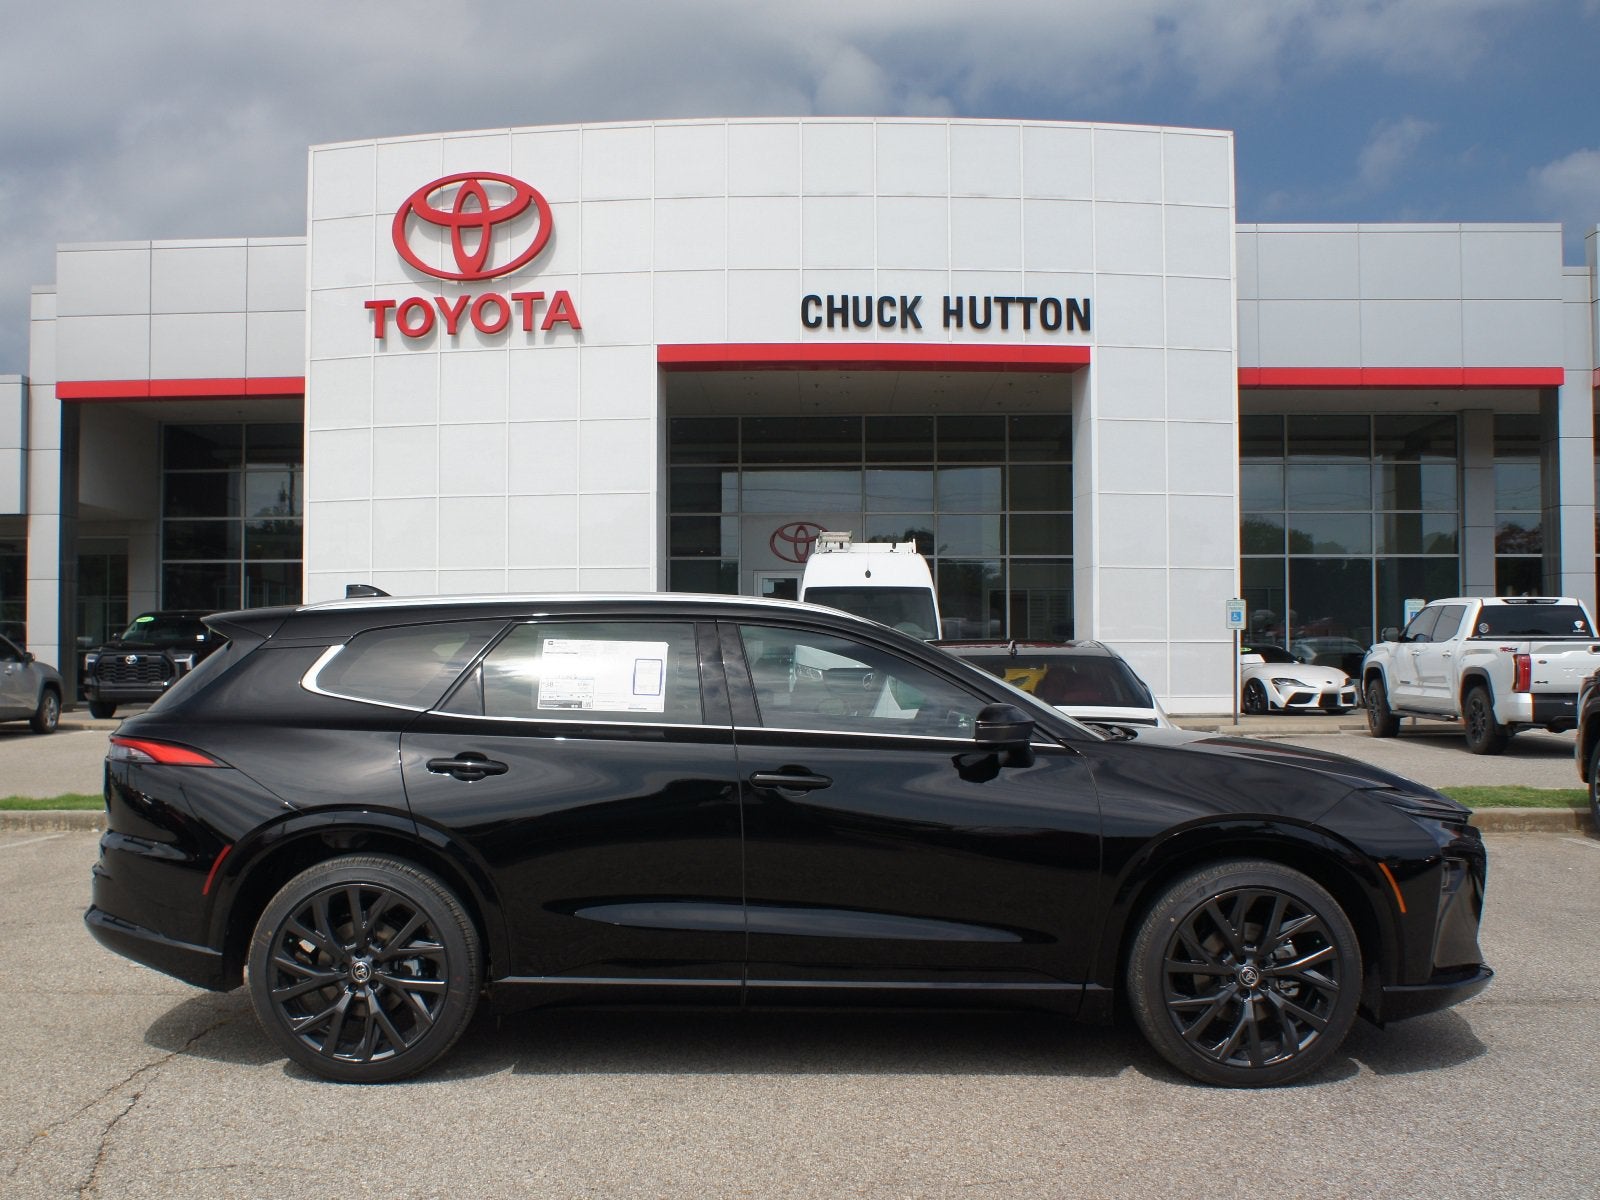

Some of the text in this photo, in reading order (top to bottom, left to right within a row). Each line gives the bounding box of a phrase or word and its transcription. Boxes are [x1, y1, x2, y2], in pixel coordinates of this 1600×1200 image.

[364, 290, 582, 339] TOYOTA
[801, 294, 1091, 331] CHUCK HUTTON
